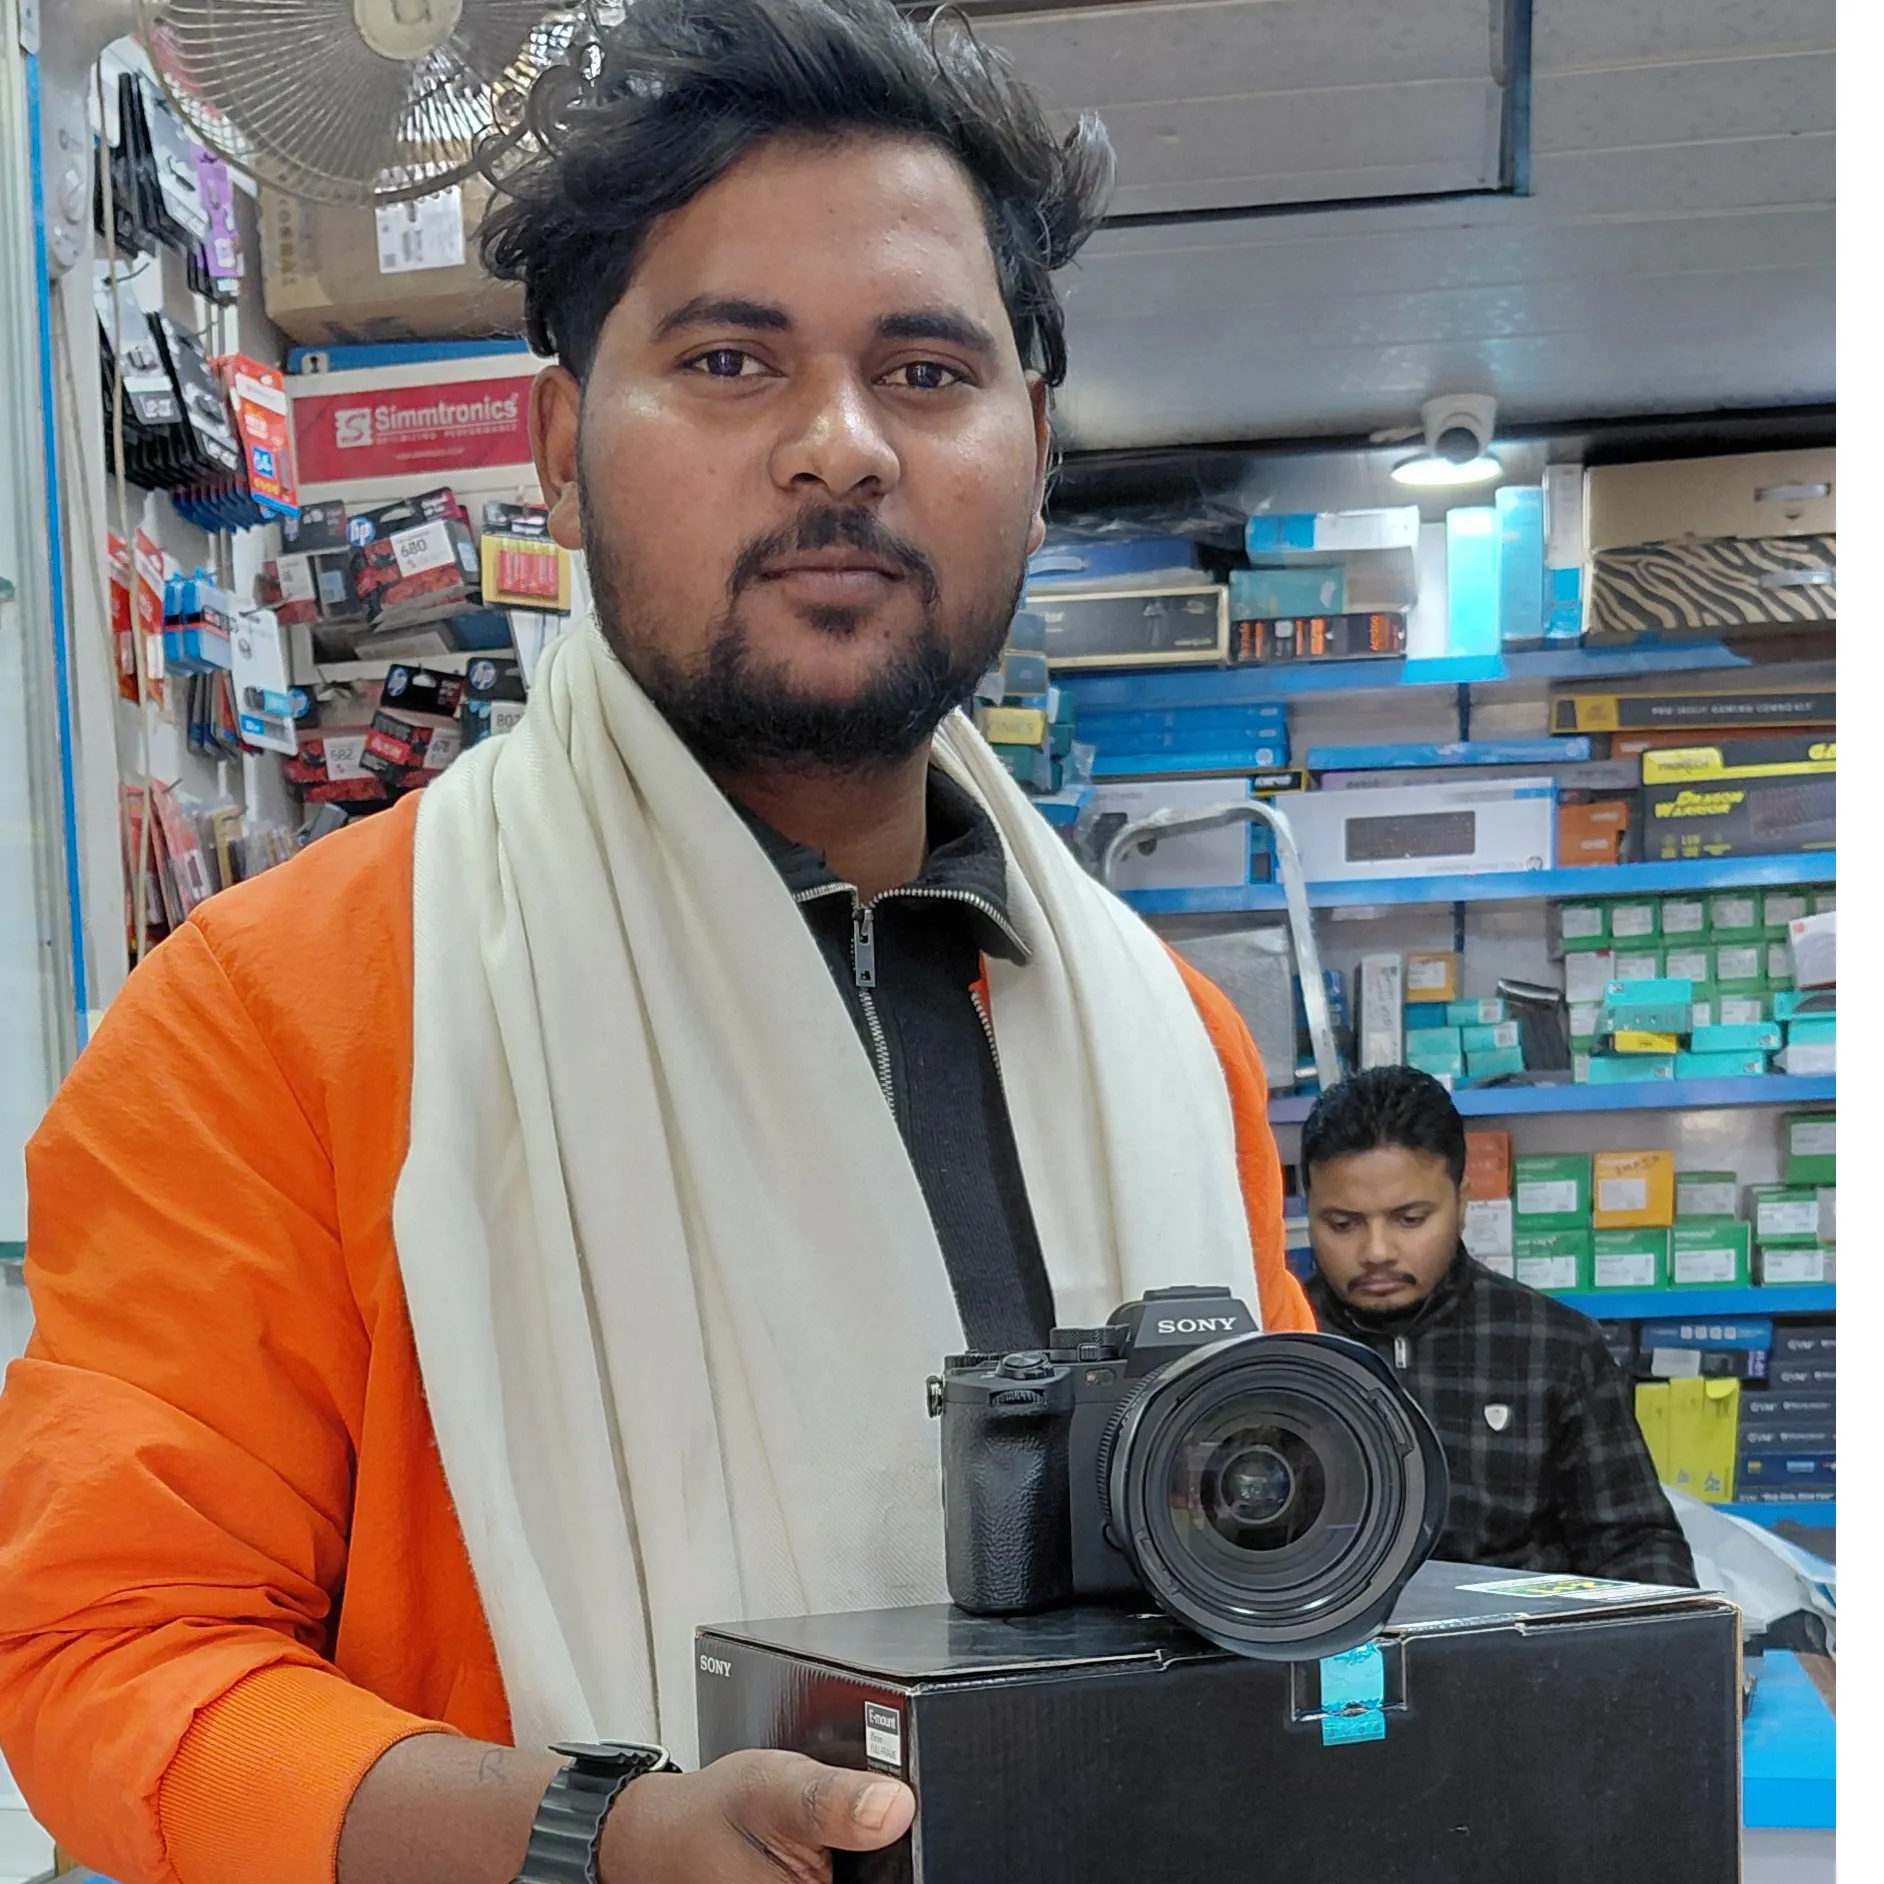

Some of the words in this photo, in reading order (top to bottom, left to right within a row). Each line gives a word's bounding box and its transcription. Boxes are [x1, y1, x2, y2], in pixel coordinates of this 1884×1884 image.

[375, 394, 517, 431] Simmtronics
[349, 520, 374, 547] hp
[400, 538, 428, 558] 680
[1157, 1316, 1237, 1334] SONY
[700, 1654, 732, 1678] SONY
[869, 1709, 896, 1729] E-mount
